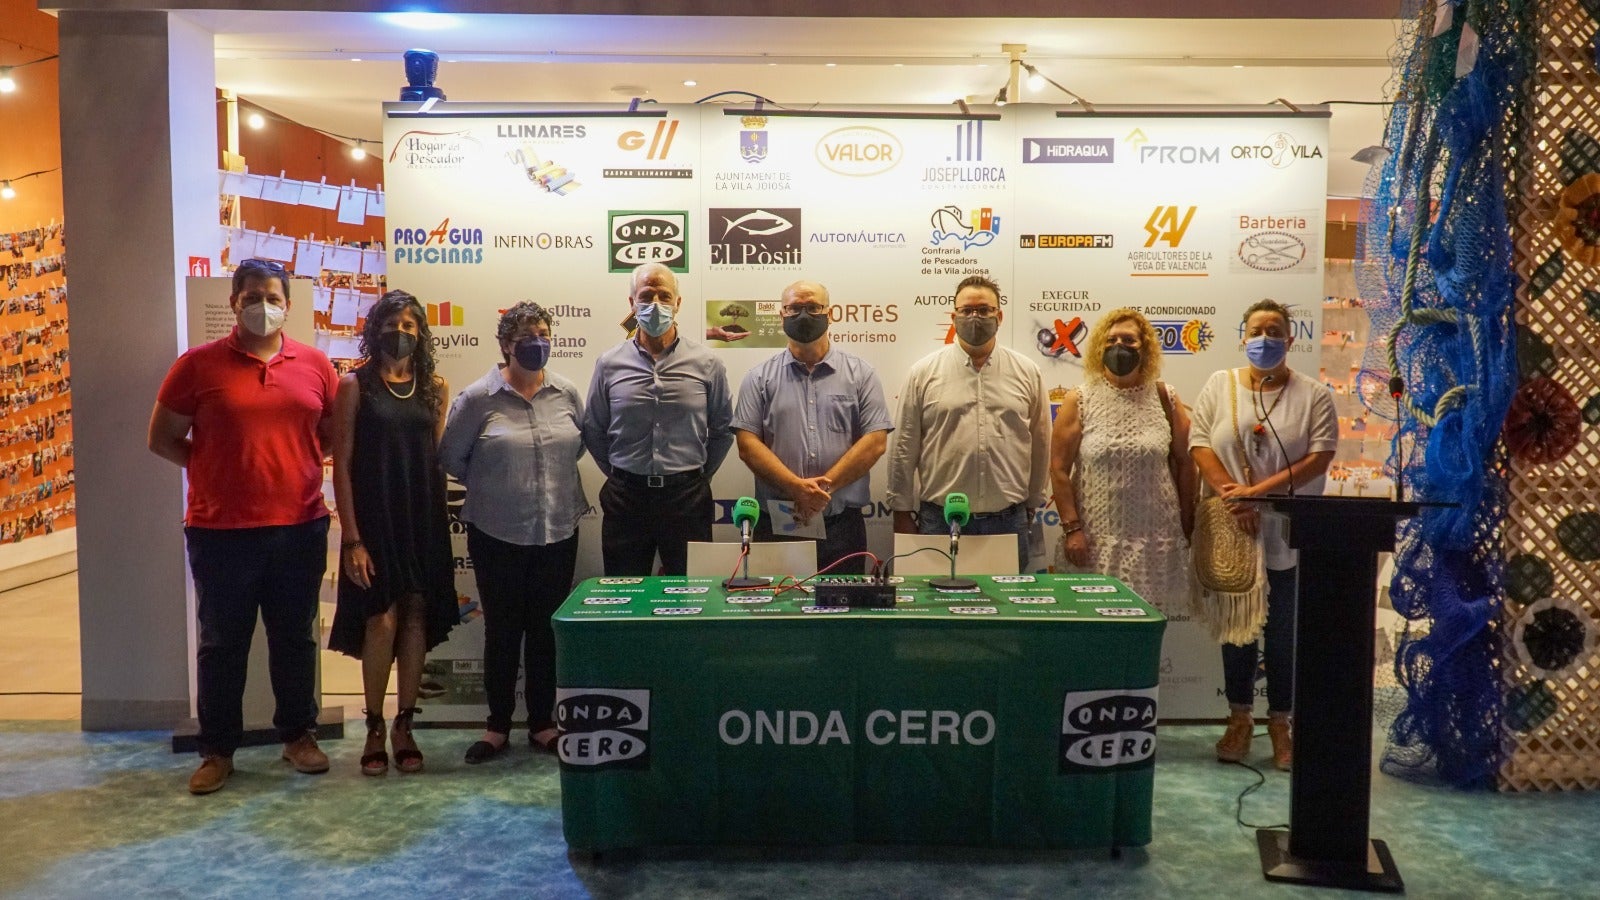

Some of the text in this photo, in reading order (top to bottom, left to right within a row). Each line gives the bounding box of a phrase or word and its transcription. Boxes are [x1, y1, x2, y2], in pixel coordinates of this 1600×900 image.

[497, 125, 586, 138] LLINARES
[405, 138, 446, 155] Hogar
[824, 144, 893, 161] VALOR
[1231, 146, 1323, 159] ORTO VILA
[405, 153, 465, 165] Pescador
[1141, 146, 1220, 164] PROM
[715, 172, 792, 181] AJUNTAMENT DE
[715, 182, 792, 190] LA VILA JOIOSA
[1240, 216, 1306, 229] Barberia
[621, 225, 674, 238] ONDA
[810, 230, 905, 243] AUTONÁUTICA
[625, 246, 674, 259] CERO
[709, 243, 802, 265] El Pòsit
[1128, 252, 1213, 260] AGRICULTORES DE LA
[1132, 261, 1207, 270] VEGA DE VALENCIA
[1042, 291, 1089, 300] EXEGUR
[1029, 302, 1101, 312] SEGURIDAD
[1145, 306, 1216, 315] ACONDICIONADO
[558, 704, 633, 722] ONDA
[1079, 705, 1154, 725] ONDA
[718, 709, 996, 746] ONDA CERO
[562, 736, 633, 758] CERO
[1080, 738, 1152, 760] CERO
